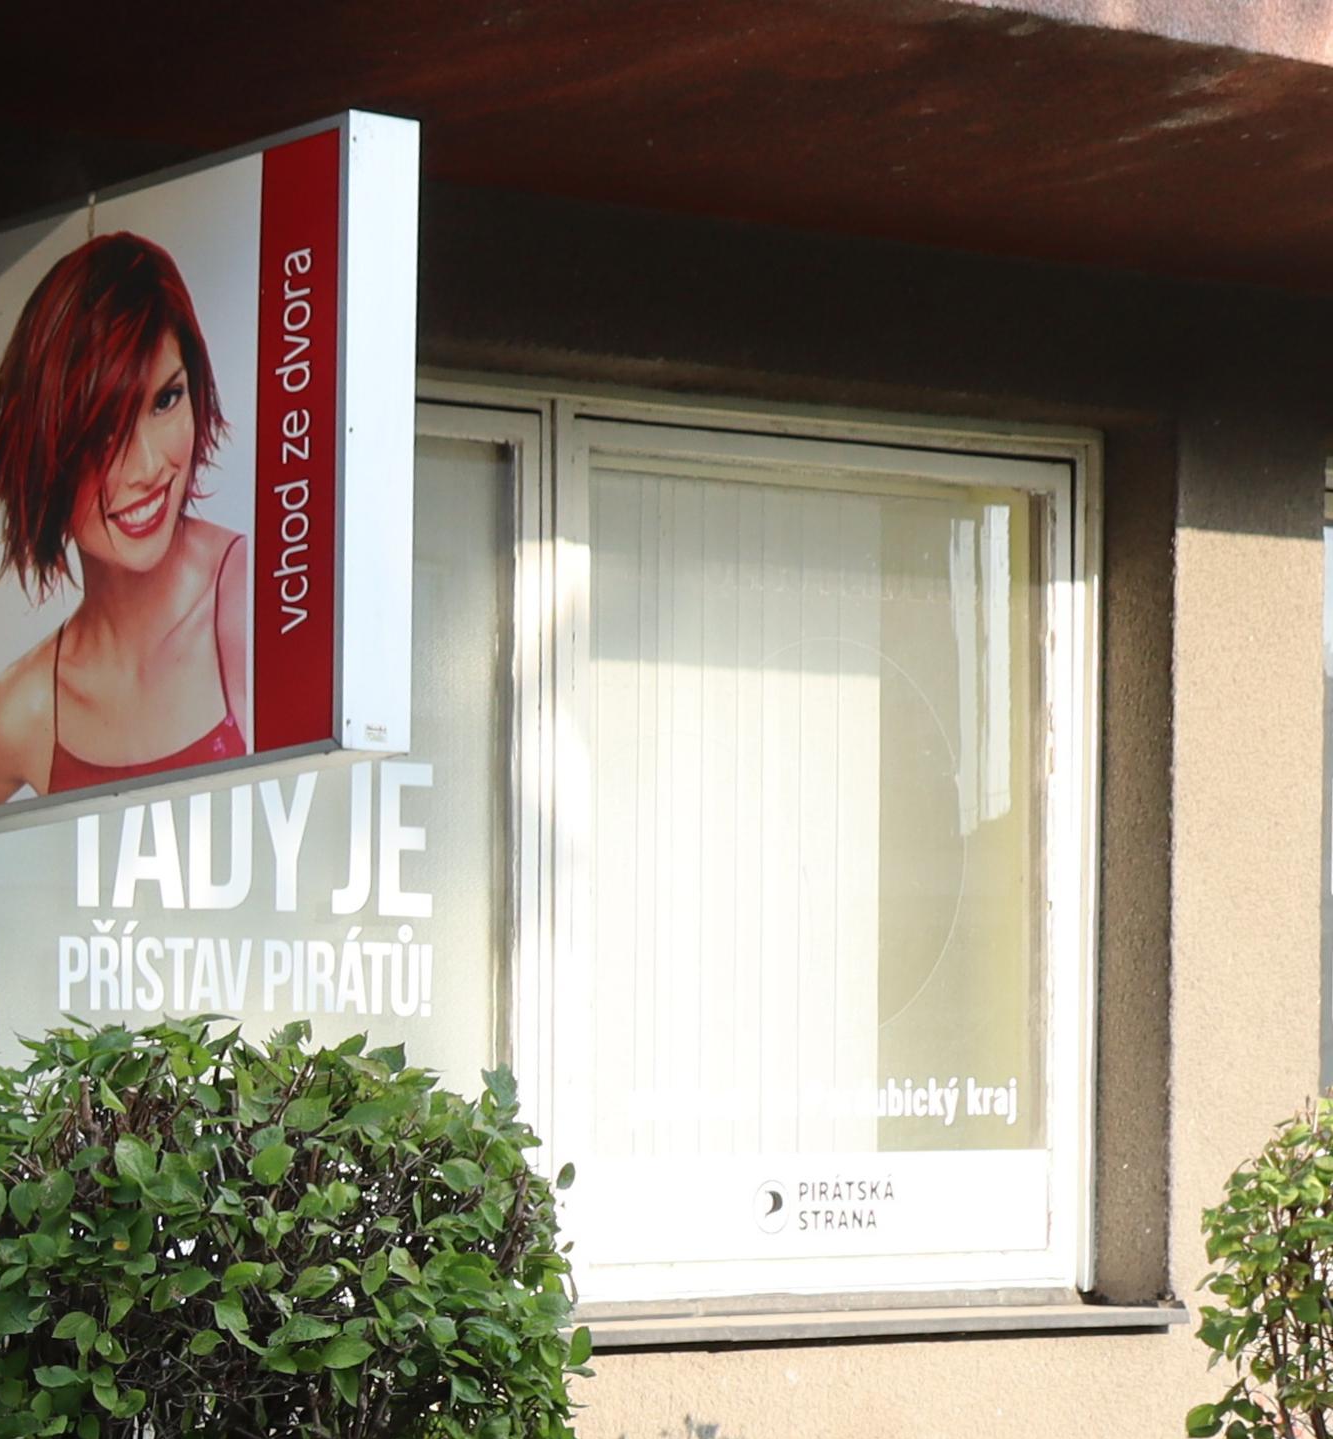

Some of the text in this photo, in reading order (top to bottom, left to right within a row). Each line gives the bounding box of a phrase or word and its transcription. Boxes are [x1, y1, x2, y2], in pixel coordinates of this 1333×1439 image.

[273, 246, 314, 636] vchod ze dvora
[332, 761, 434, 918] JE
[58, 919, 433, 1018] PŘÍSTAV PIRÁTŮ!
[966, 1076, 1018, 1126] kraj
[798, 1173, 895, 1202] PIRÁTSKÁ
[798, 1209, 878, 1231] STRANA
